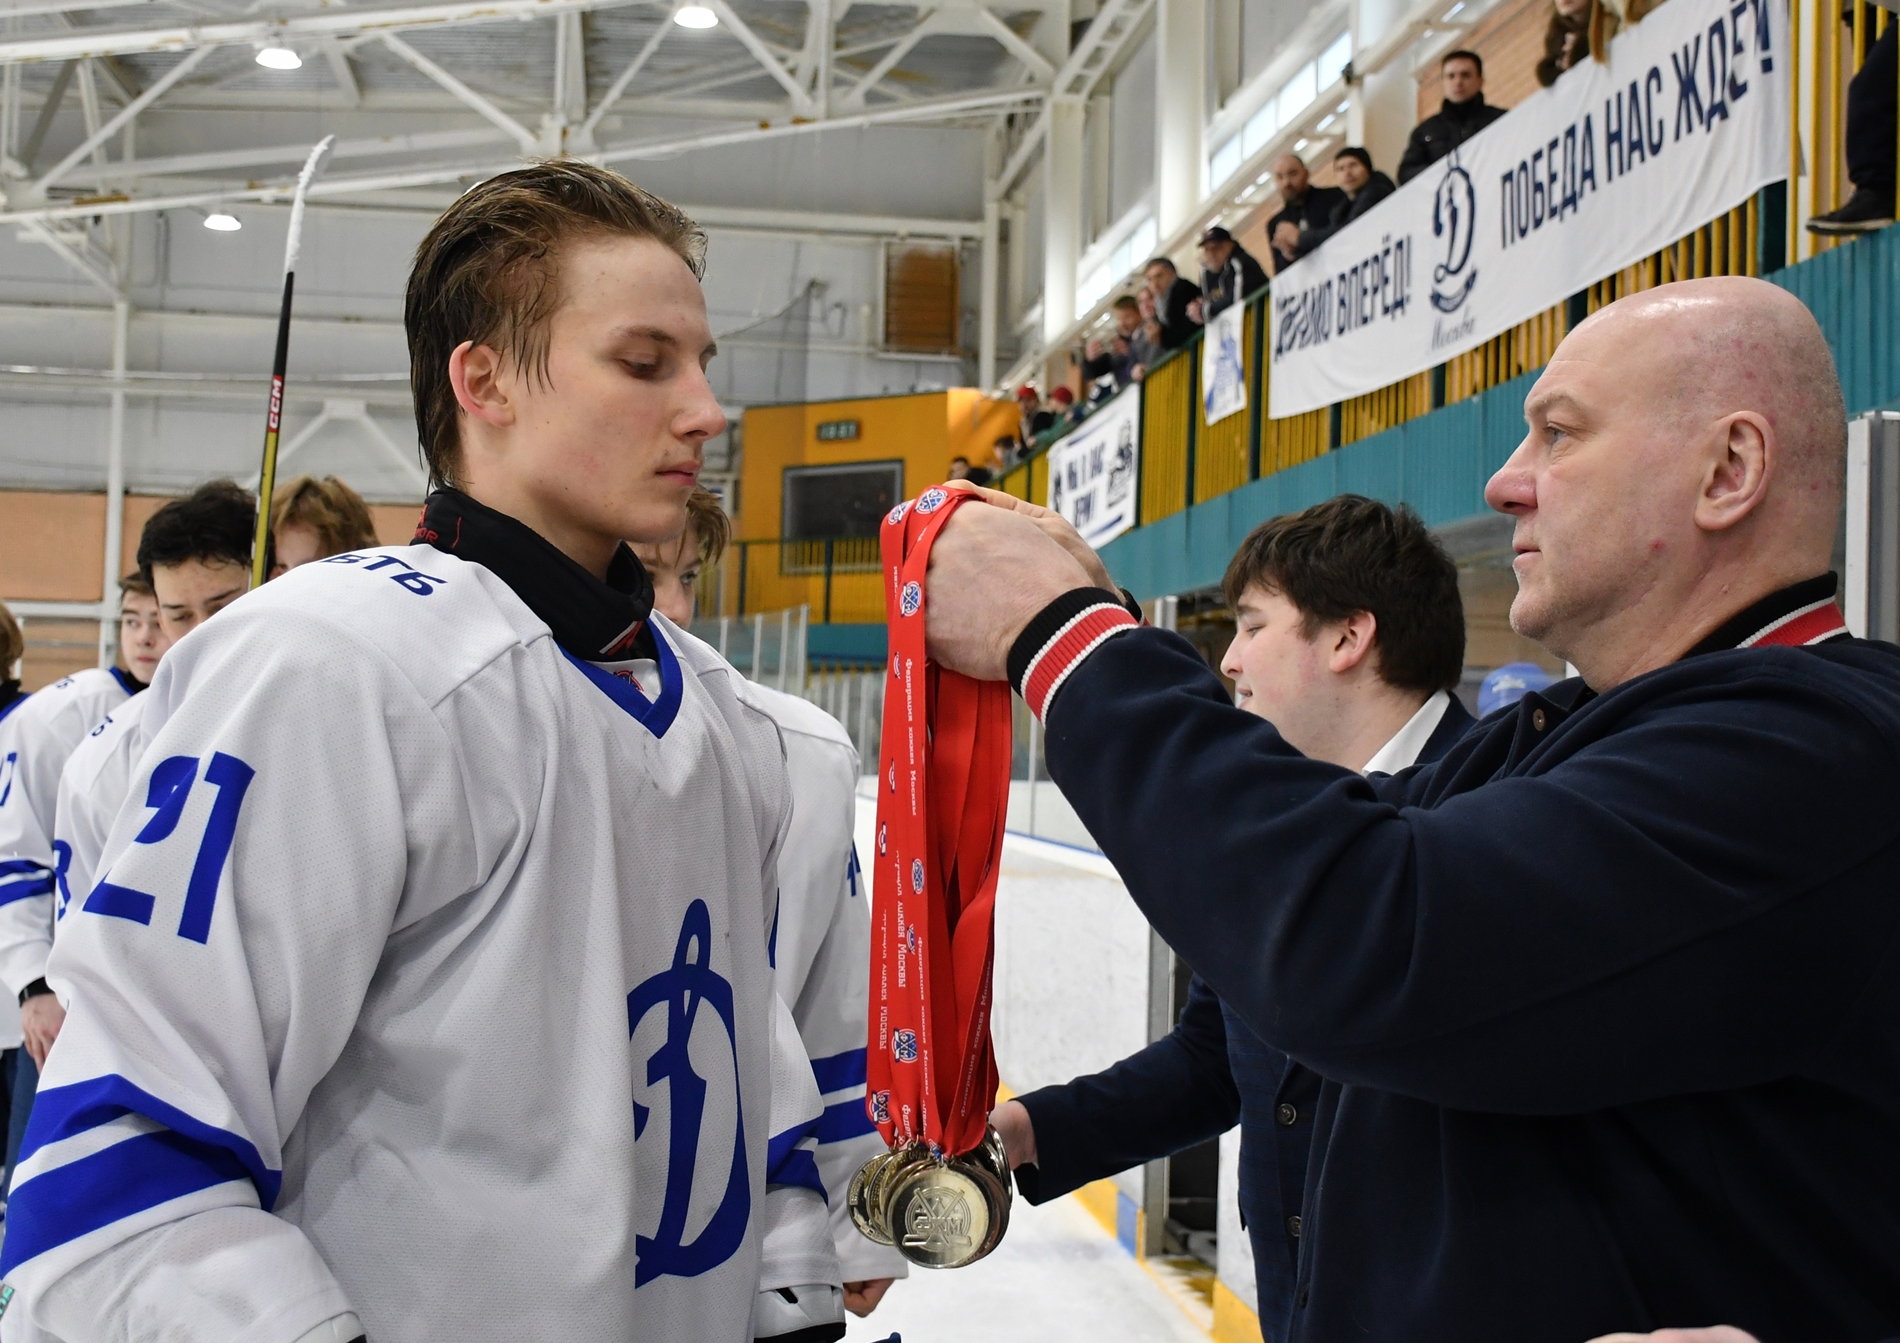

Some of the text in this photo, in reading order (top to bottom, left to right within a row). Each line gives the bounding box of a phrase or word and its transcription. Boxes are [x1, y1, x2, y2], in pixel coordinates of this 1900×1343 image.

[1500, 112, 1597, 250] ПОБЕДА
[1605, 65, 1664, 183] НАС
[1336, 233, 1412, 337] ВПЕРЁД!
[269, 378, 282, 429] CCM
[904, 658, 914, 722] Федерация
[909, 769, 917, 816] Москвы
[82, 751, 256, 945] 21
[897, 943, 906, 988] Москвы
